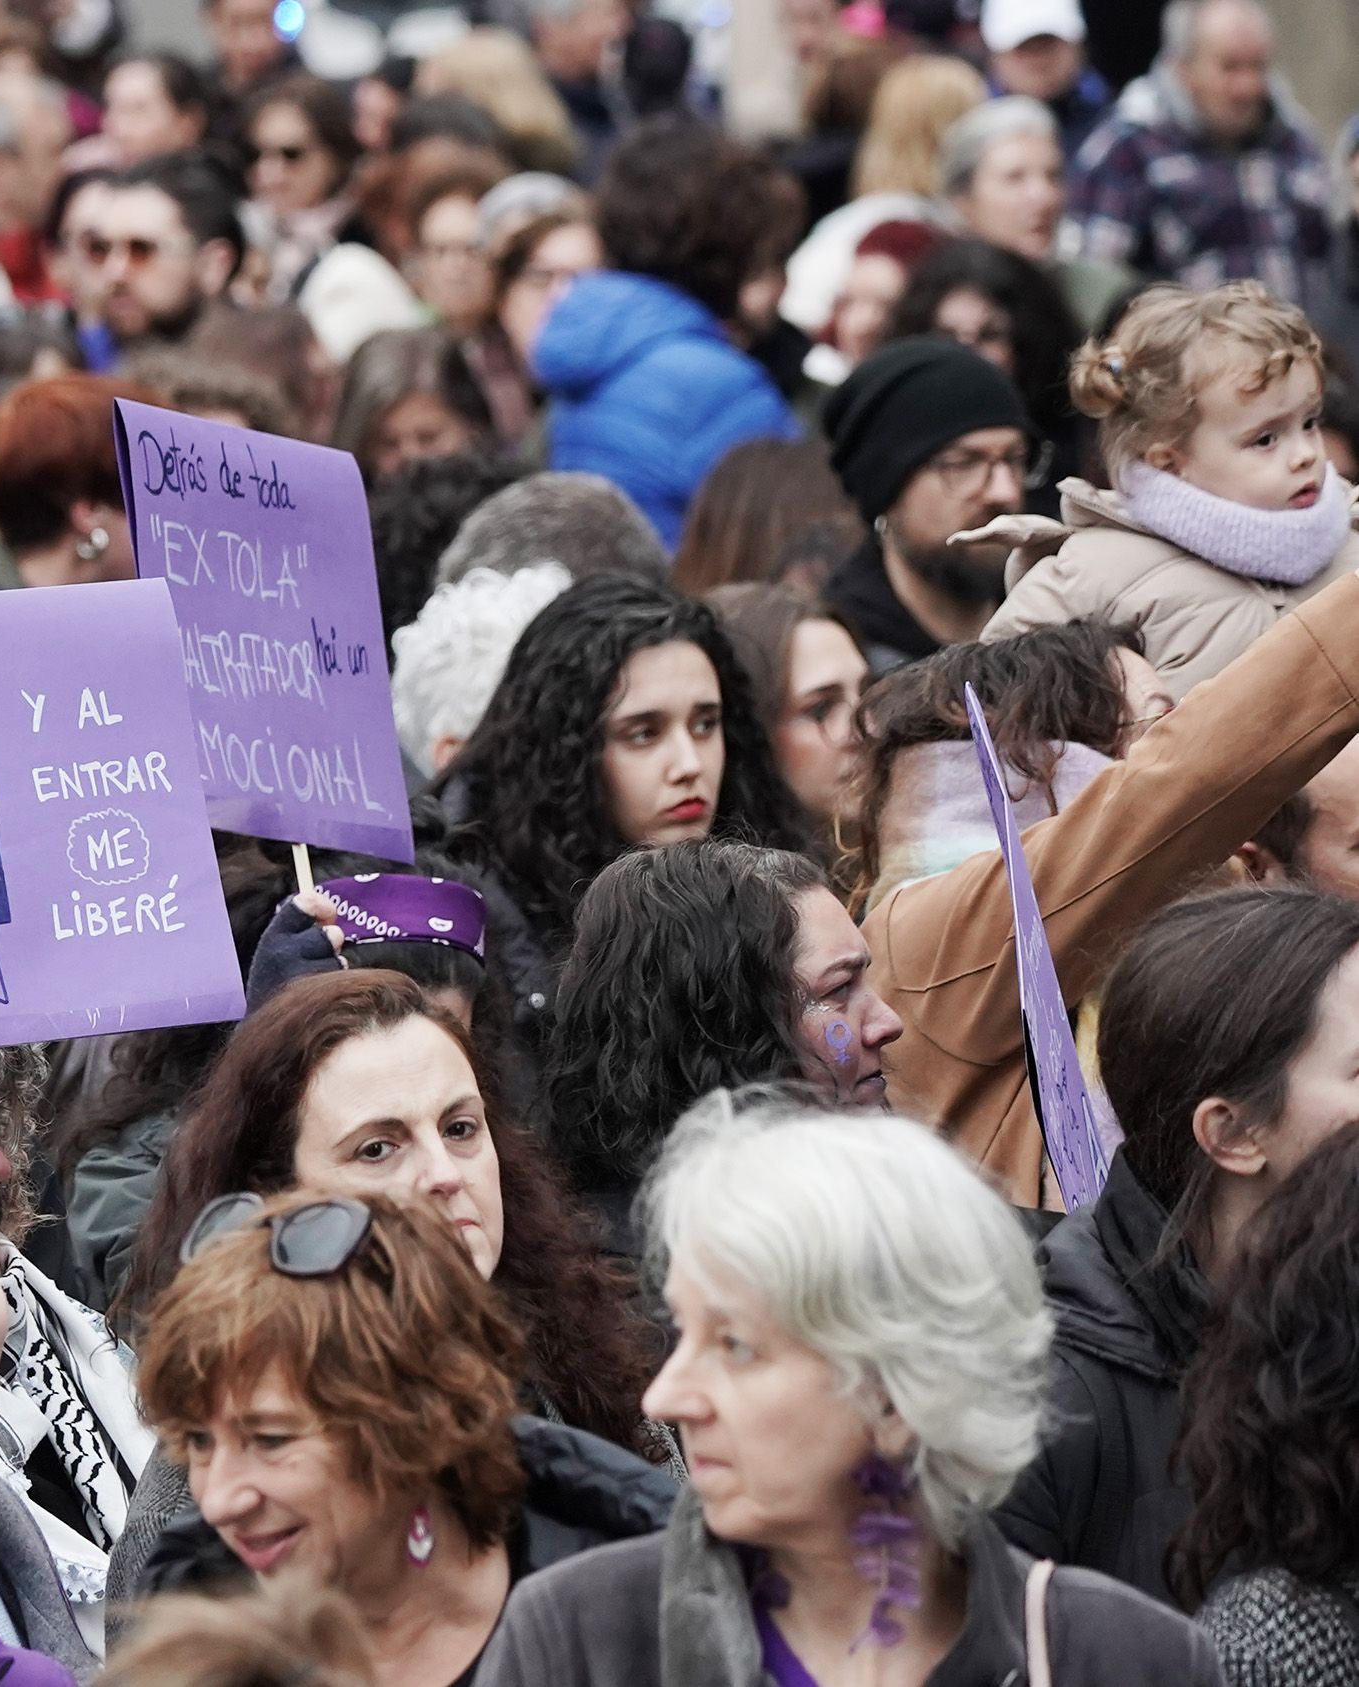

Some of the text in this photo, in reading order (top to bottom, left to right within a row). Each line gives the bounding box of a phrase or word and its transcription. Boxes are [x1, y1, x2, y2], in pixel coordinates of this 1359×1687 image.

[138, 427, 296, 510] Detrás de toda
[150, 513, 308, 608] "EX TOLA"
[347, 643, 369, 676] un
[20, 686, 123, 733] Y AL
[31, 751, 173, 803] ENTRAR
[87, 828, 136, 871] ME
